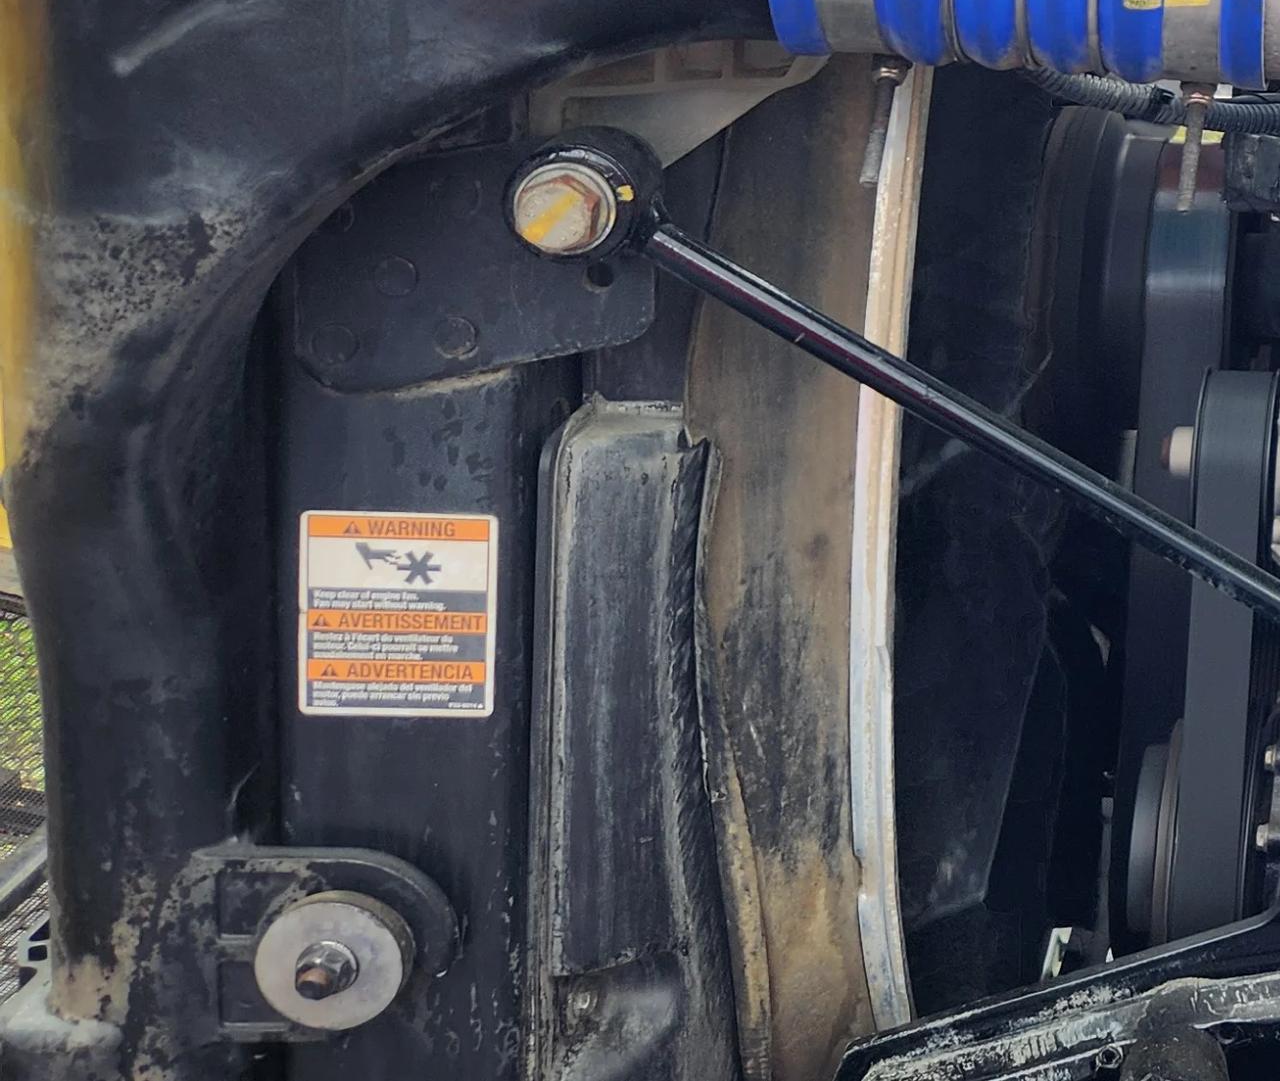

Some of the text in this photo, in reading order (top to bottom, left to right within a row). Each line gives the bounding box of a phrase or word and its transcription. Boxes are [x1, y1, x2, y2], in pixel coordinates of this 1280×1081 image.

[367, 520, 456, 537] WARNING
[314, 590, 337, 600] Keep
[337, 591, 360, 599] clear
[360, 591, 370, 599] of
[371, 592, 401, 601] engine
[314, 599, 447, 611] Fan may start without warning.
[338, 613, 483, 630] AVERTISSEMENT
[346, 662, 473, 680] ADVERTENCIA
